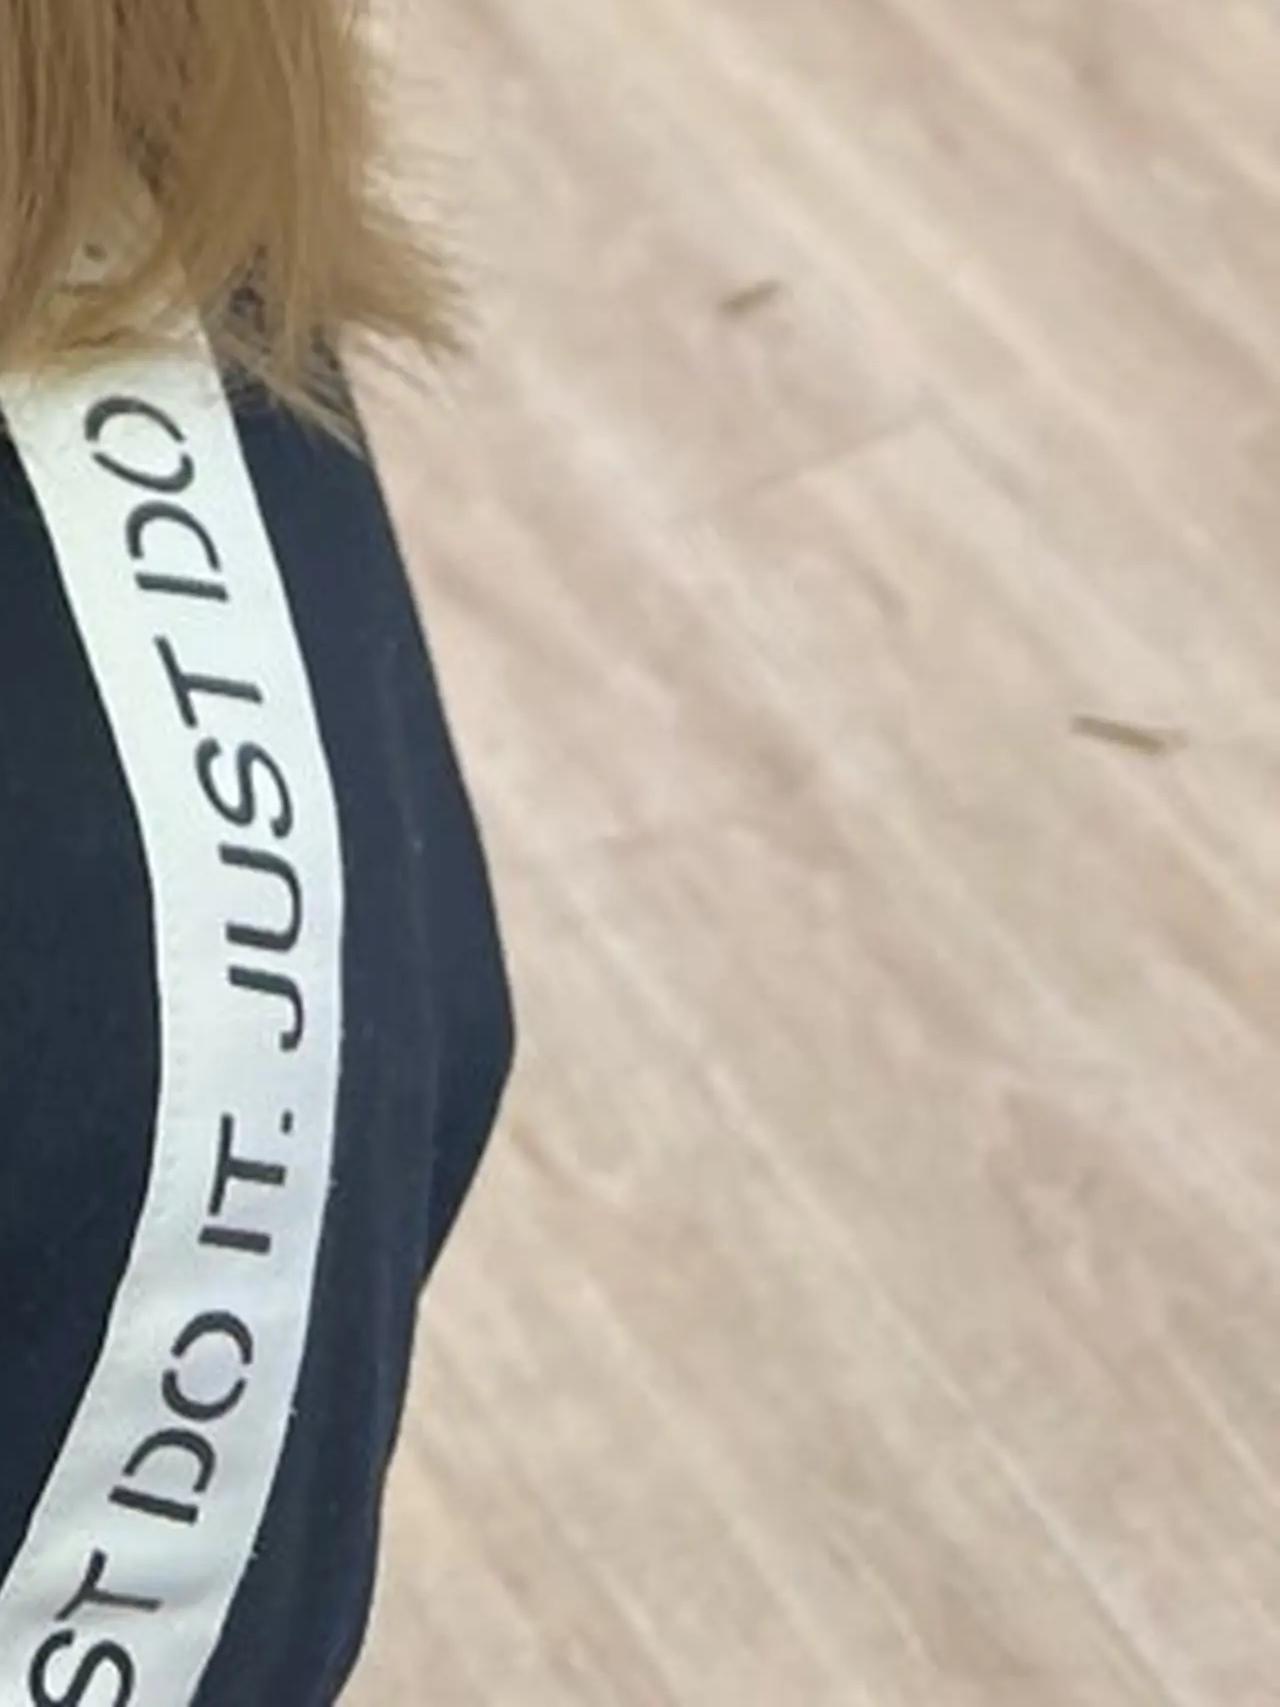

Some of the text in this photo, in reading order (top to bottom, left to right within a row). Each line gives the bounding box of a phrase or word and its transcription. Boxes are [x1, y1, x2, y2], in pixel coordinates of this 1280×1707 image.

[83, 395, 228, 603] DO
[155, 637, 305, 1053] JUST
[197, 1112, 295, 1255] IT.
[107, 1309, 255, 1526] DO
